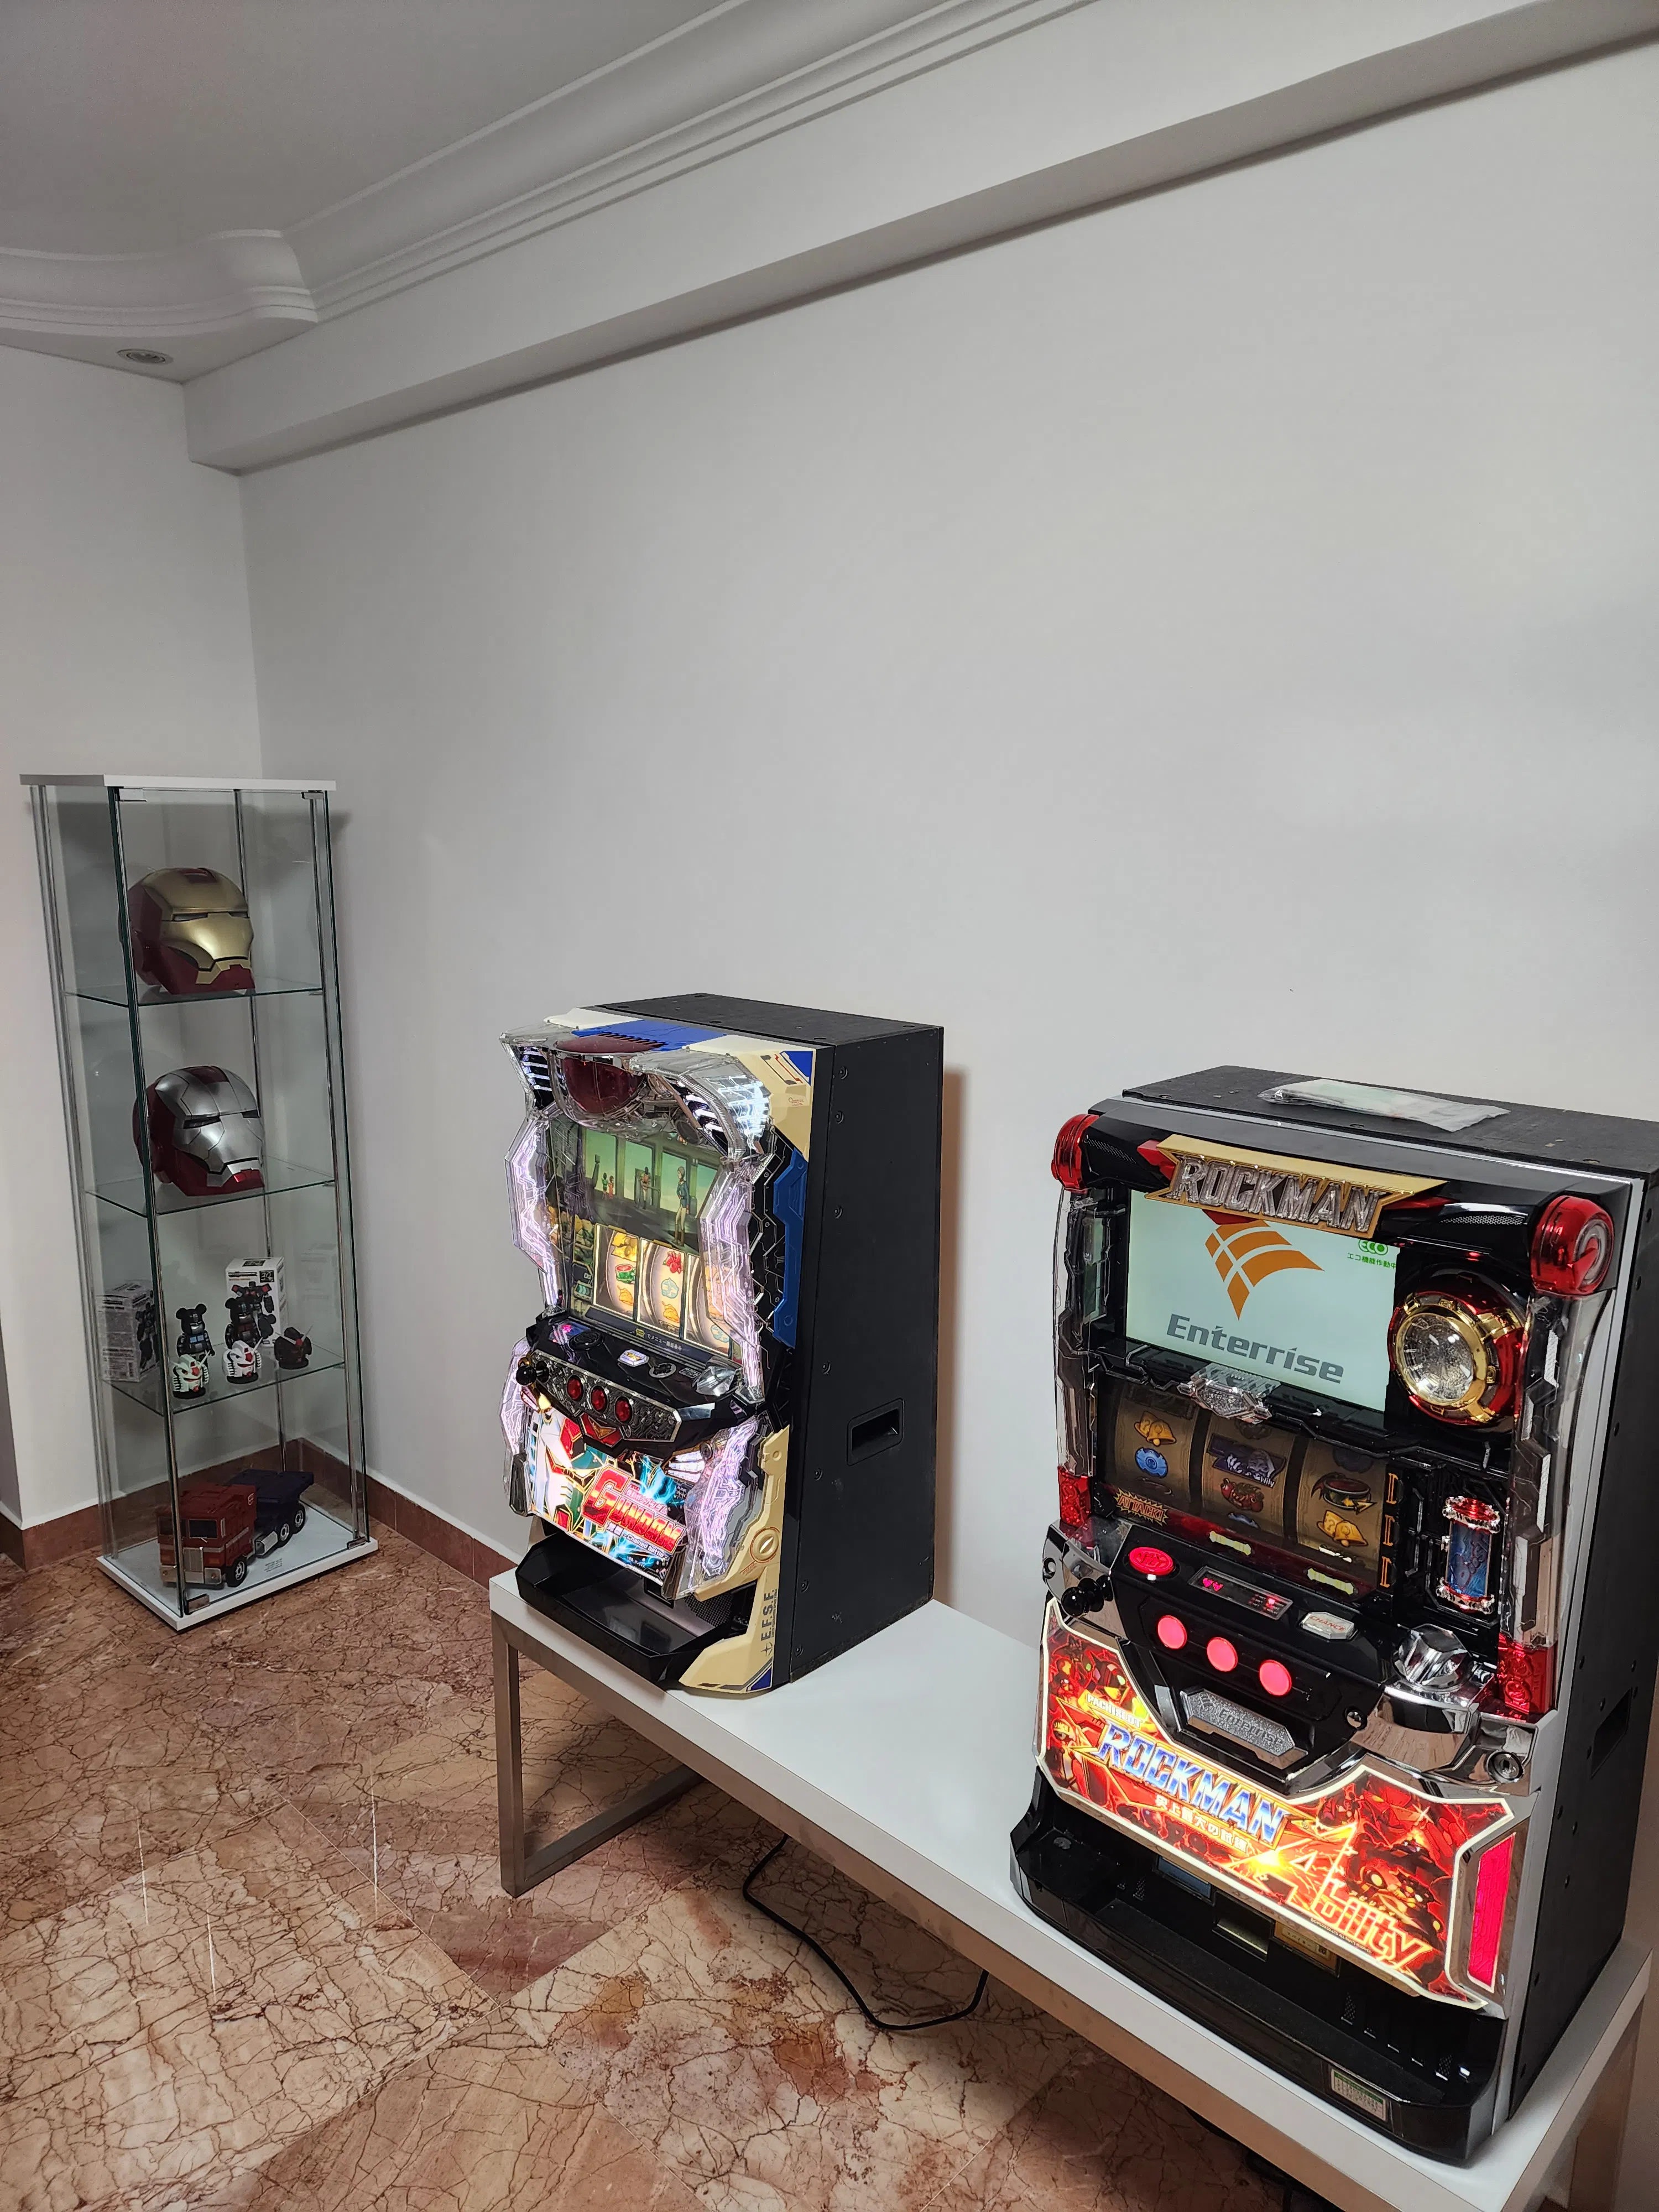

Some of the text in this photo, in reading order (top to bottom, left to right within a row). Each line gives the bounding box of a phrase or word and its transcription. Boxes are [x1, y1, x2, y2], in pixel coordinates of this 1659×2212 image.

[1165, 1154, 1386, 1233] ROCKMAN
[1166, 1313, 1344, 1384] Enterrise
[582, 1465, 686, 1554] GUNDAM
[761, 1589, 774, 1641] E.F.S.F.
[1310, 1615, 1346, 1631] CHANCE
[1087, 1694, 1142, 1728] PACHISLOT
[1095, 1721, 1290, 1844] ROCKMAN
